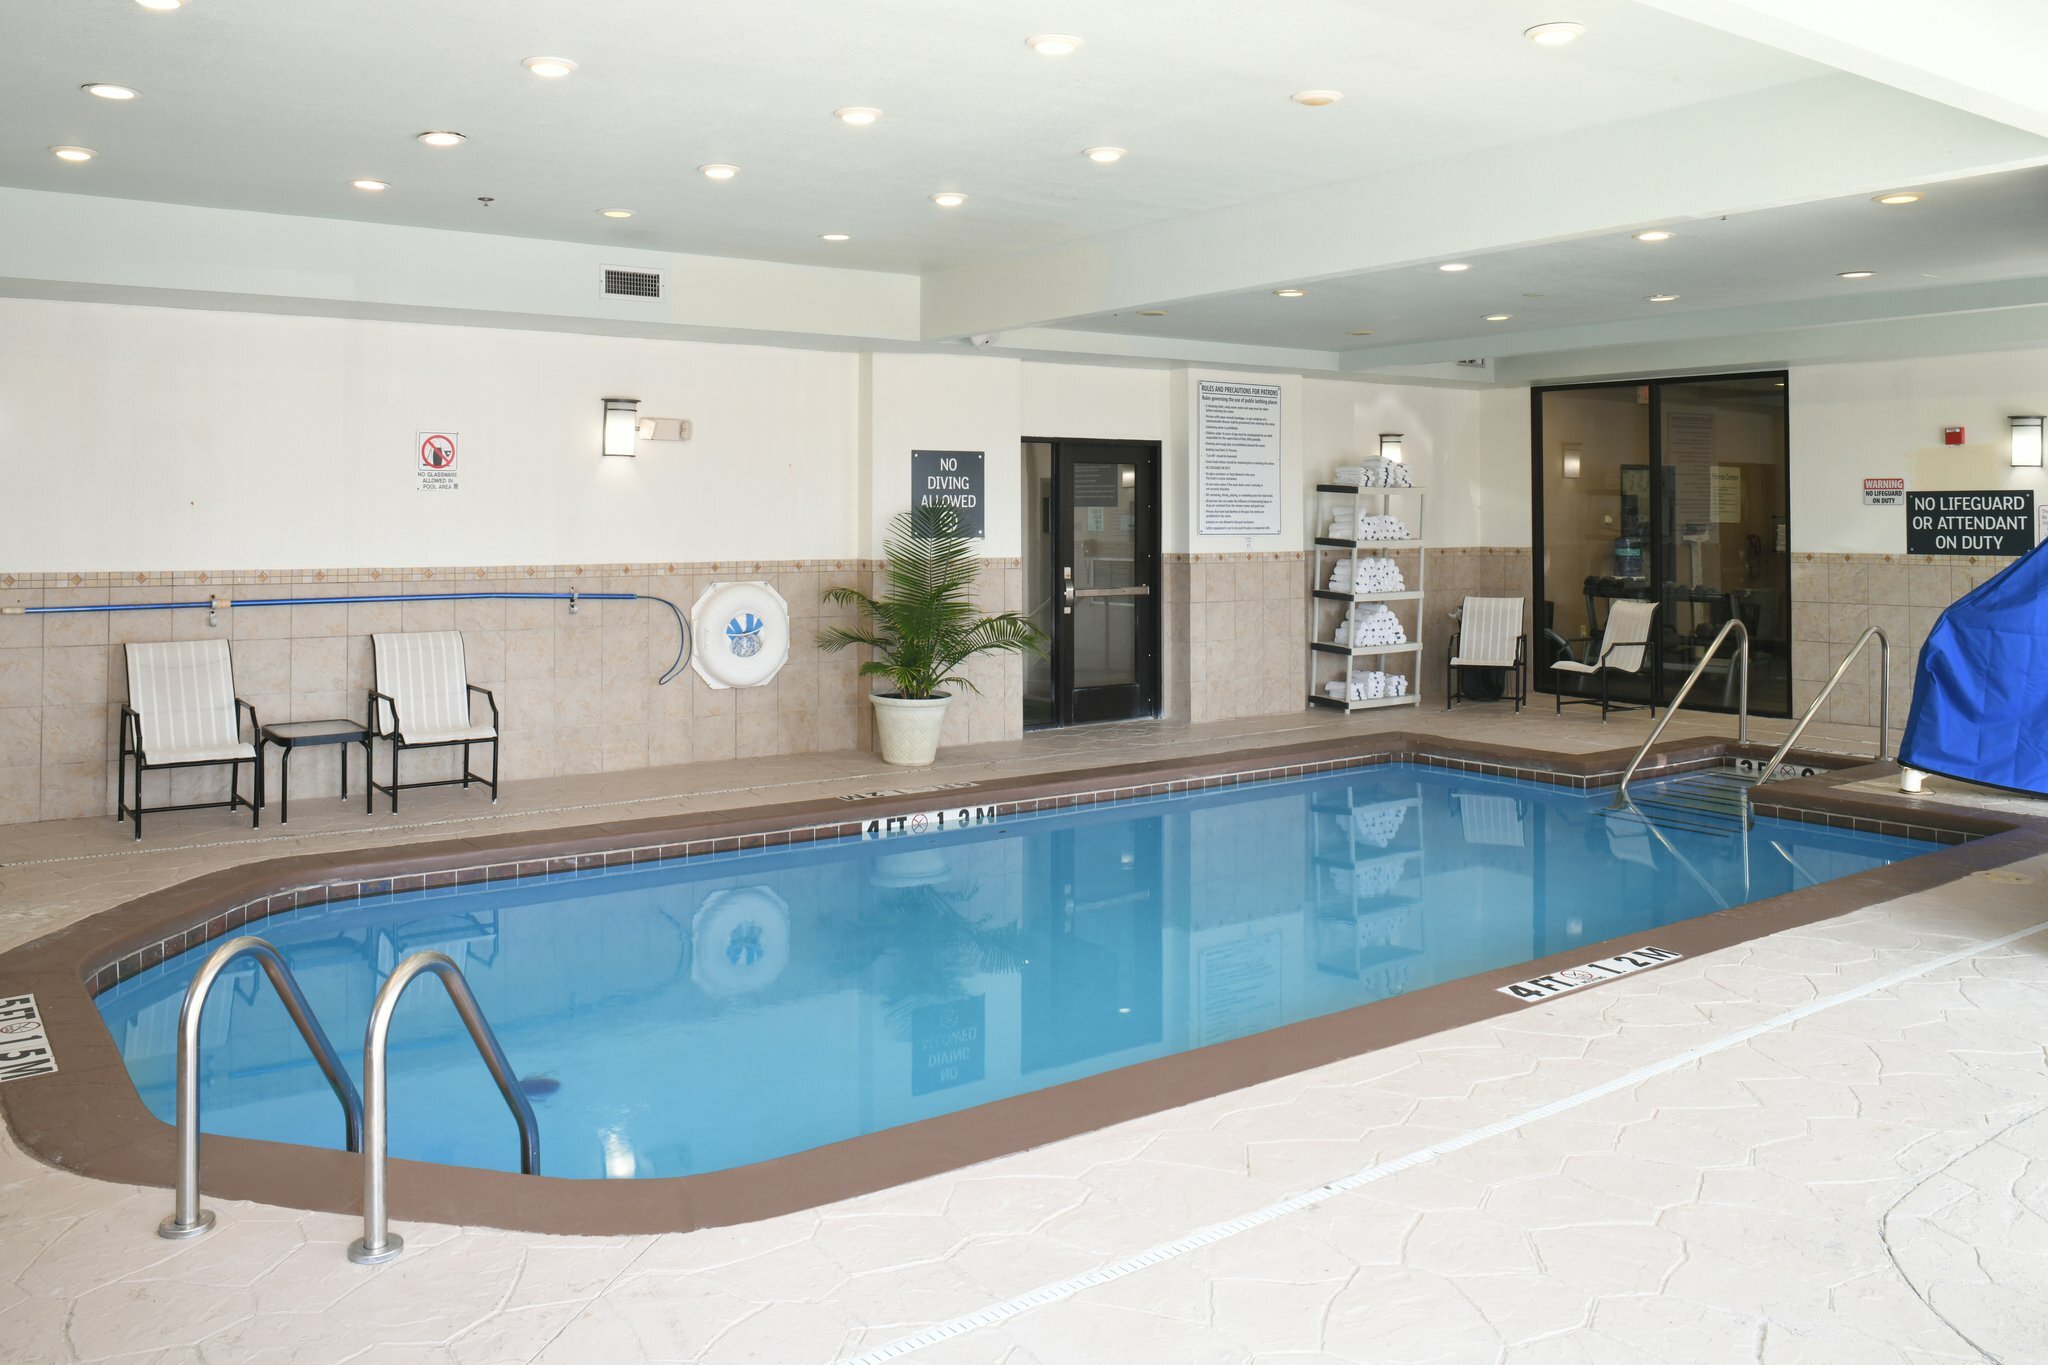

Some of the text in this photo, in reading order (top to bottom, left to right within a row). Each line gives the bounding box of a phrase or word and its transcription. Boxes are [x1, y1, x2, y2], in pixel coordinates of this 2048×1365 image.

[940, 458, 957, 471] NO
[927, 476, 969, 490] DIVING
[1865, 479, 1903, 489] WARNING
[1914, 496, 2025, 511] NO LIFEGUARD
[1912, 516, 1933, 530] OR
[1937, 515, 2028, 530] ATTENDANT
[1935, 535, 2004, 550] ON DUTY
